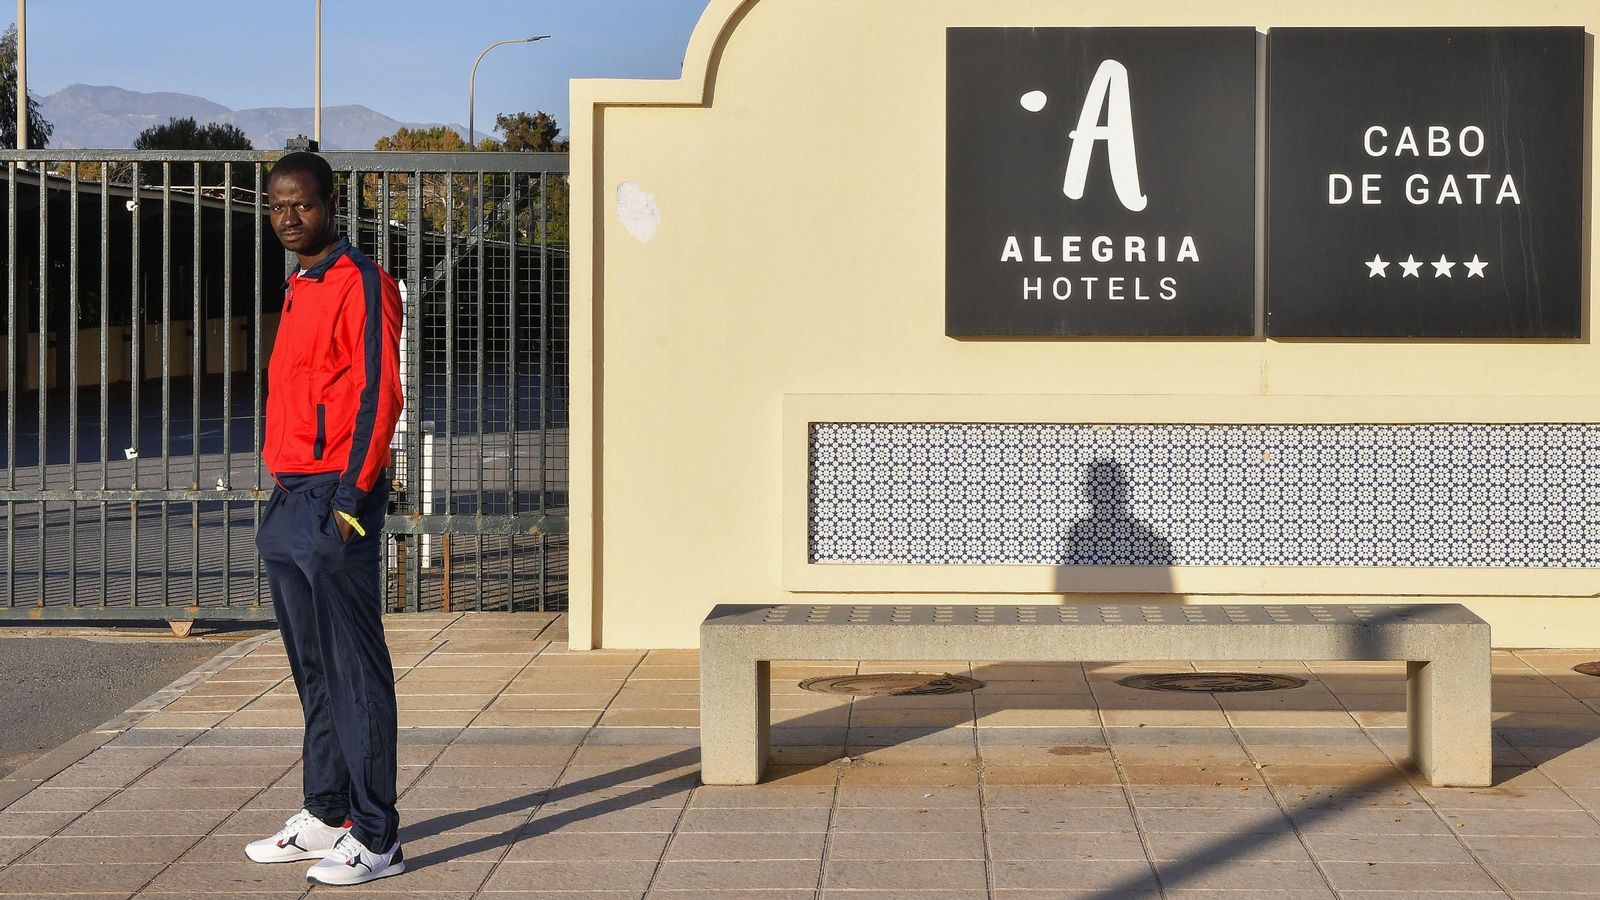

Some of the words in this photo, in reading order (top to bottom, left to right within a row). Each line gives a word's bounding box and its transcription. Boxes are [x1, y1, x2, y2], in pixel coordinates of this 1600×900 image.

[1363, 125, 1485, 157] CABO
[1328, 173, 1382, 205] DE
[1405, 173, 1521, 205] GATA
[1001, 235, 1200, 263] ALEGRIA
[1023, 276, 1178, 301] HOTELS
